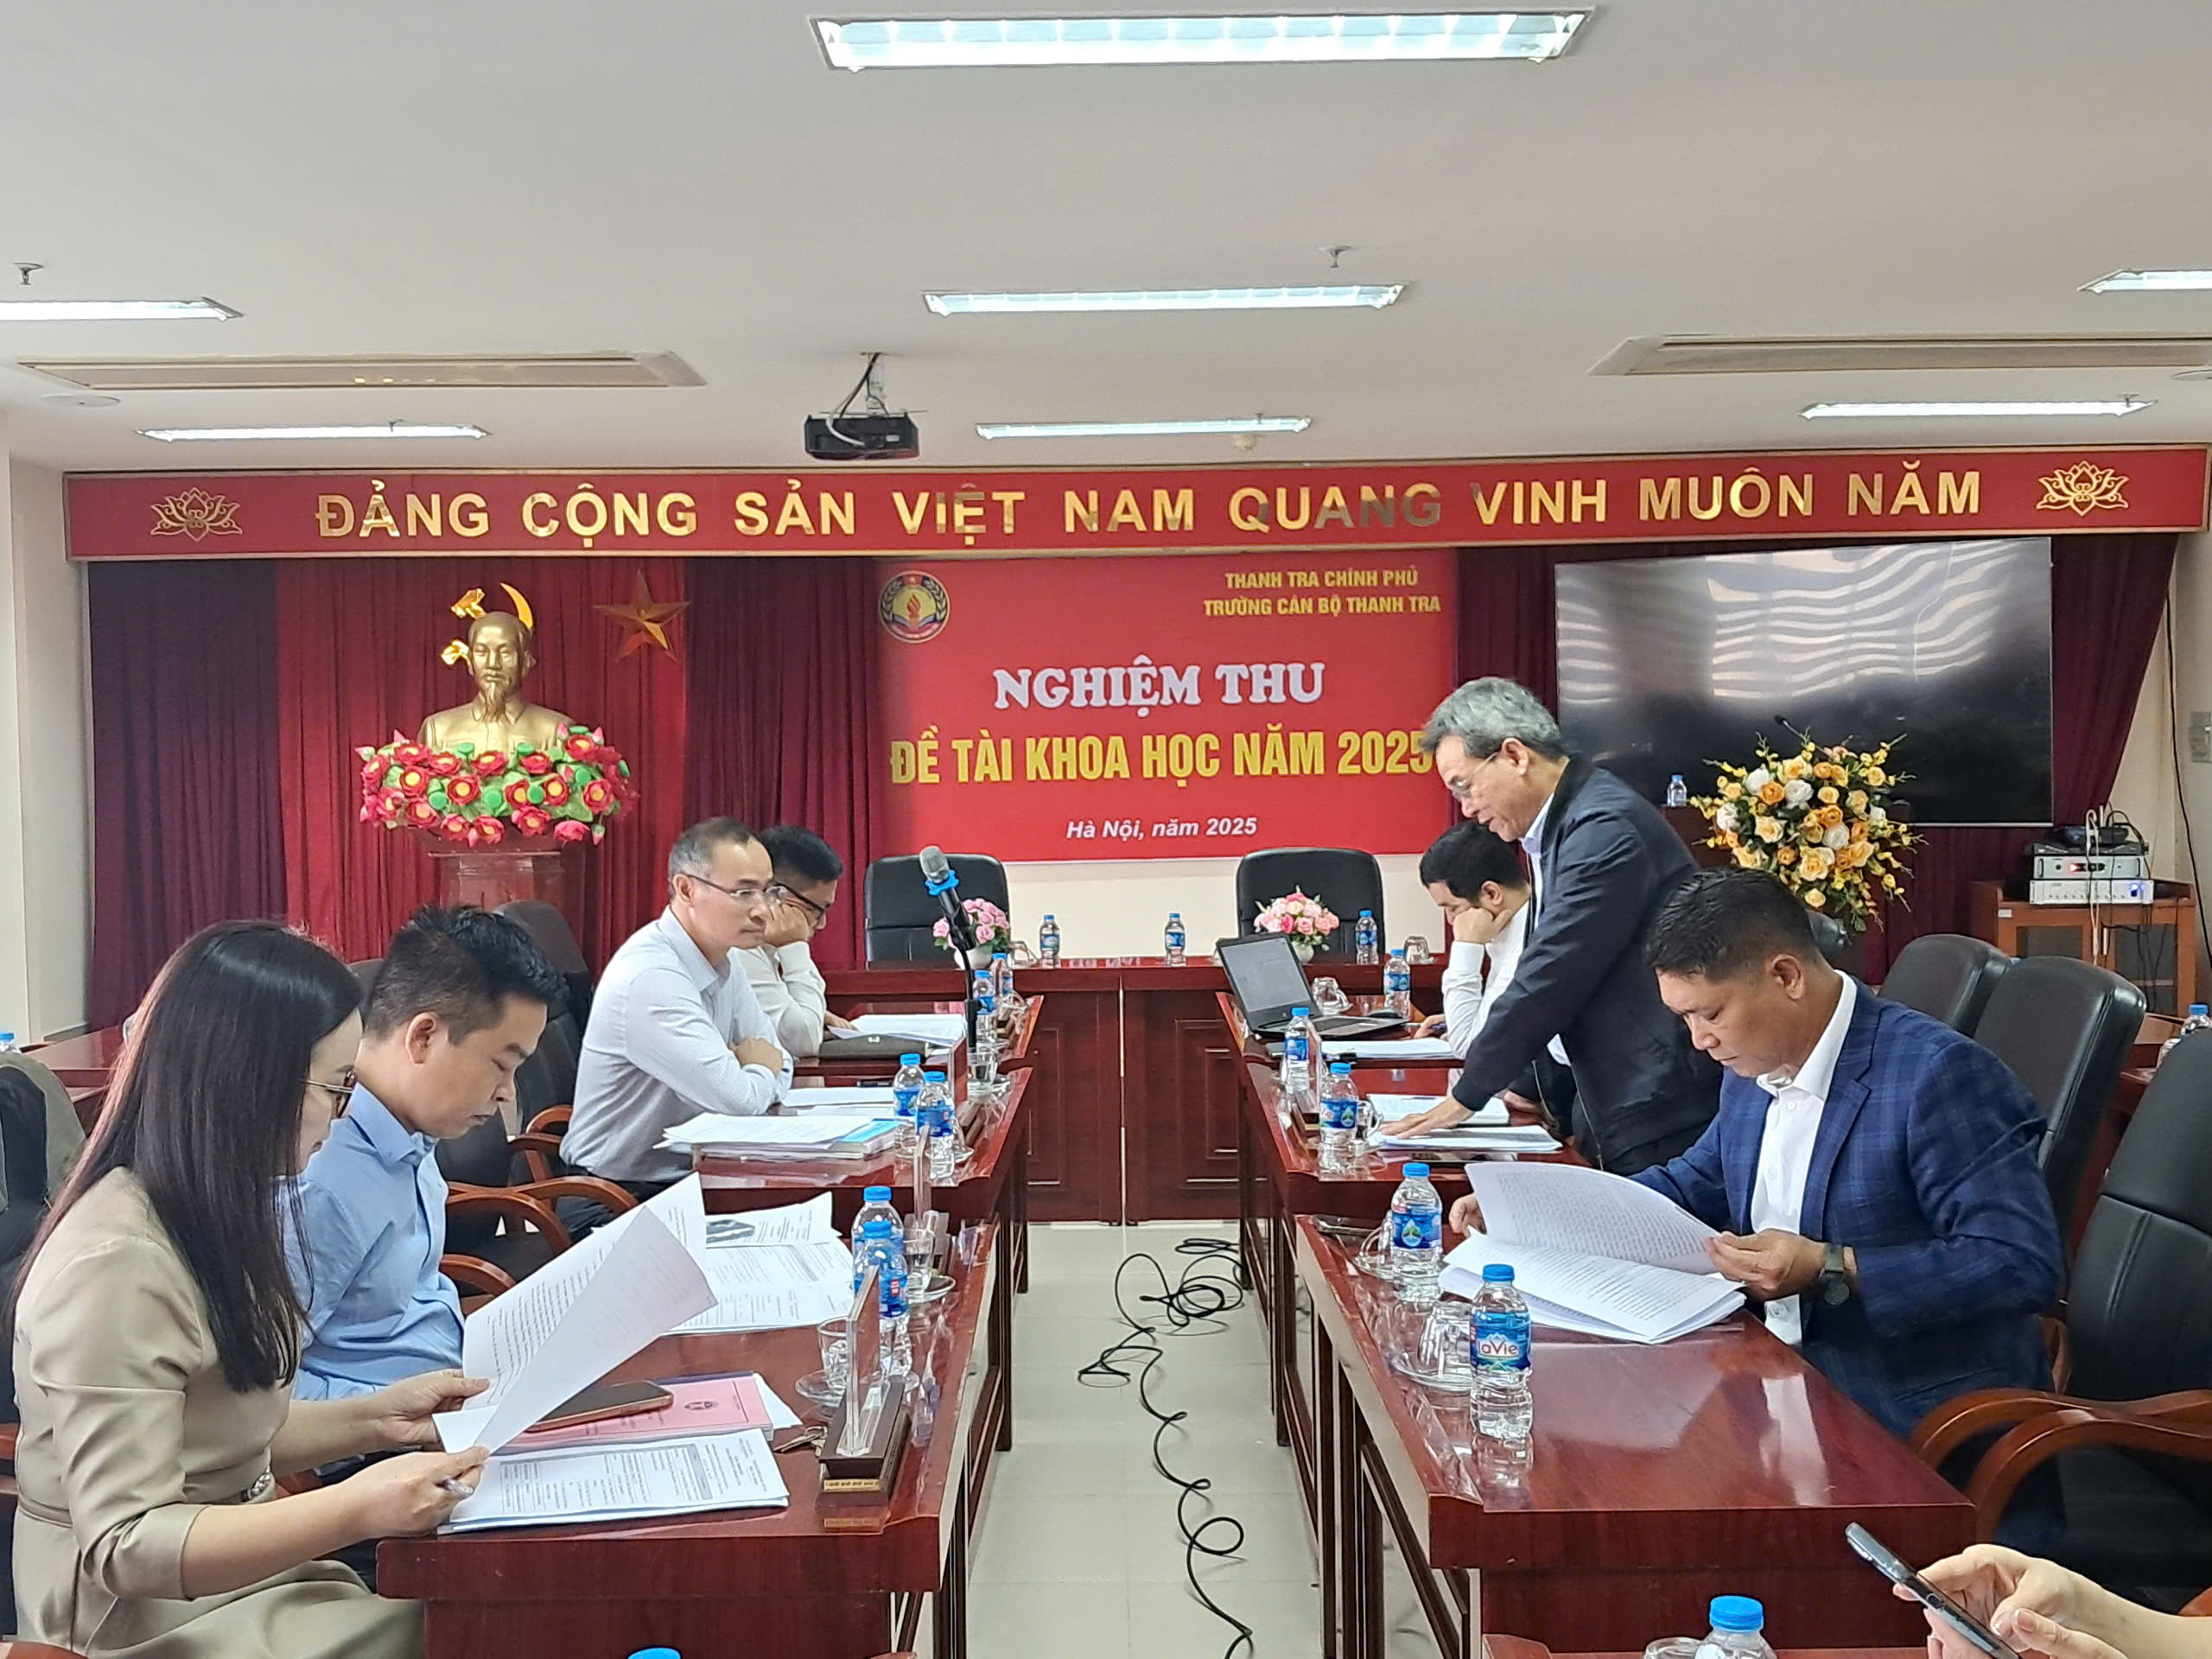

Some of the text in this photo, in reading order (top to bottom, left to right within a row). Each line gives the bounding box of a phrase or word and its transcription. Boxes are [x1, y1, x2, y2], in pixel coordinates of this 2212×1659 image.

[315, 460, 1982, 548] ĐẢNG CỘNG SẢN VIỆT NAM QUANG VINH MUÔN NĂM
[1225, 564, 1419, 588] THANH TRA CHÍNH PHỦ
[1204, 594, 1441, 617] TRƯỜNG CÁN BỘ THANH TRA
[993, 654, 1326, 717] NGHIỆM THU
[890, 723, 1433, 788] ĐỀ TÀI KHOA HỌC NĂM 2025
[1065, 817, 1258, 842] Hà Nội, năm 2025
